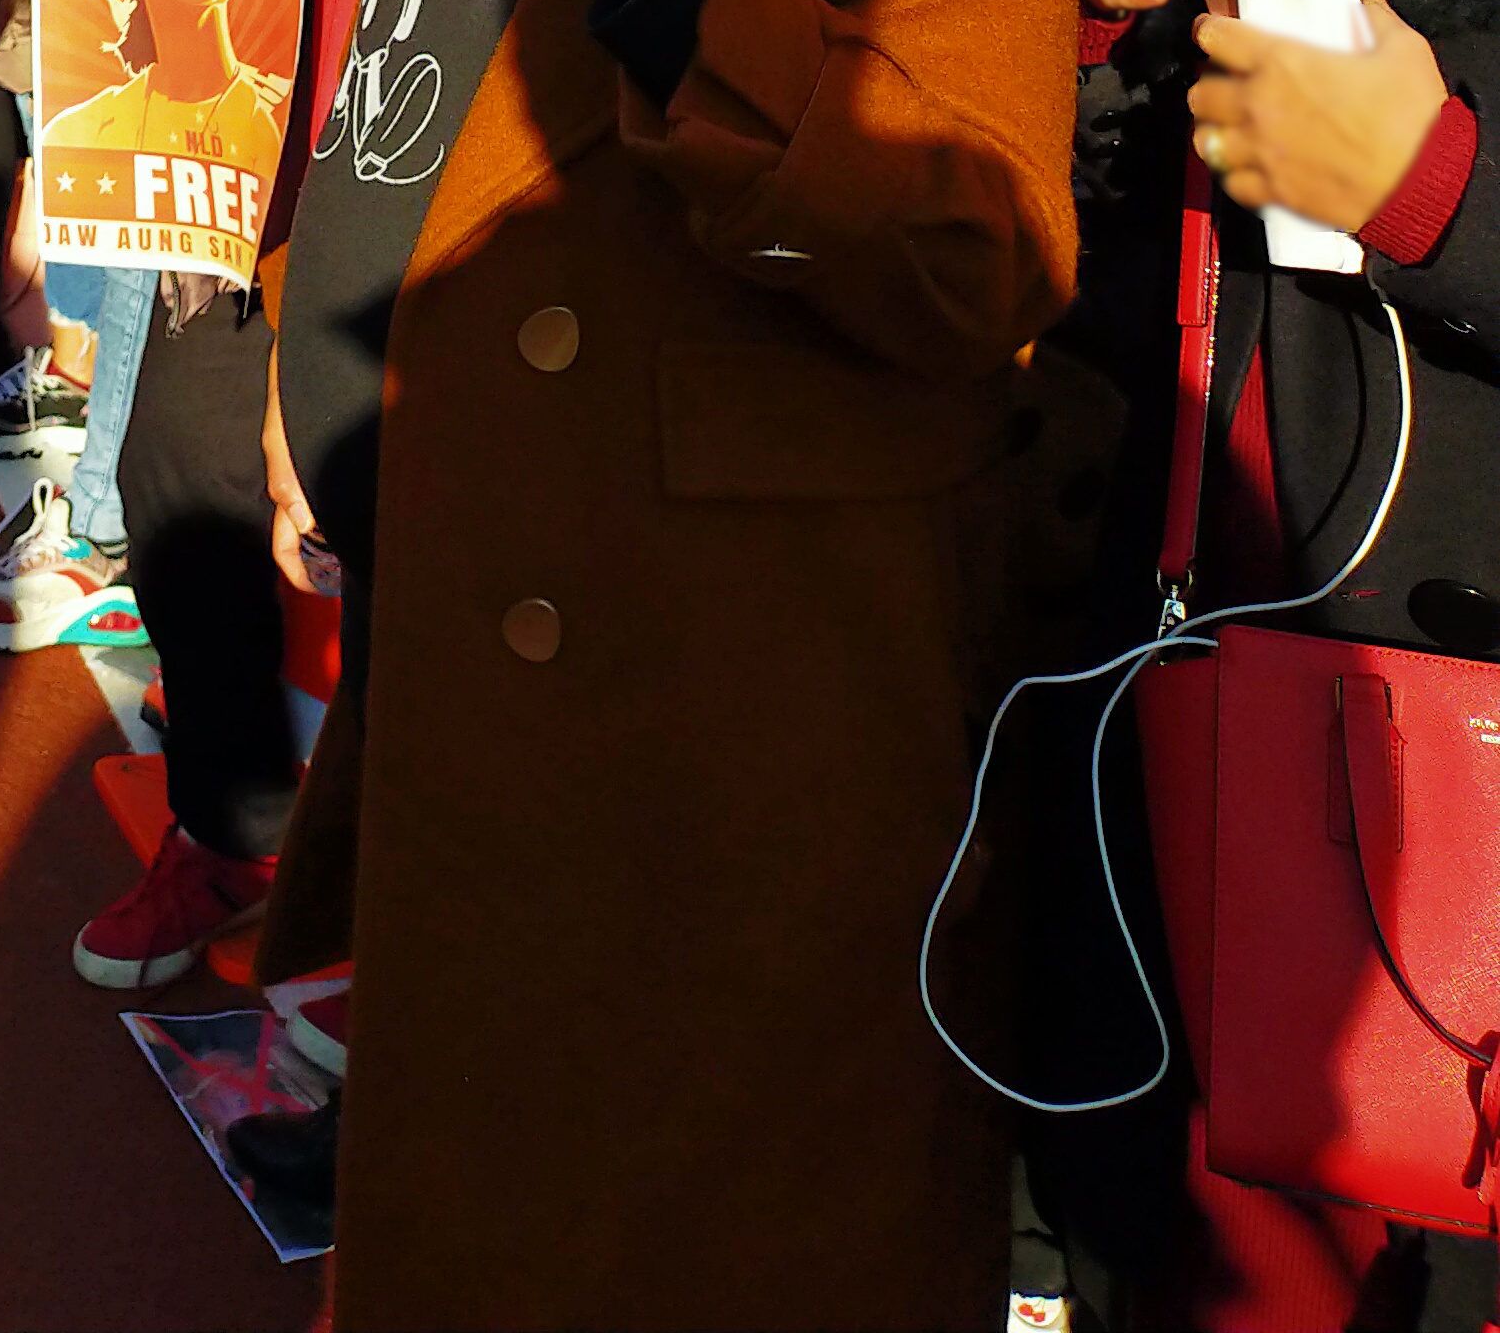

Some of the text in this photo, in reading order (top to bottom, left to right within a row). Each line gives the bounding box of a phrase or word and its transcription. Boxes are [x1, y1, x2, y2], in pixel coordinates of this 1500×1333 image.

[184, 129, 224, 158] NLD
[133, 153, 260, 245] FREE
[117, 226, 193, 254] AUNG
[209, 235, 243, 266] SAN
